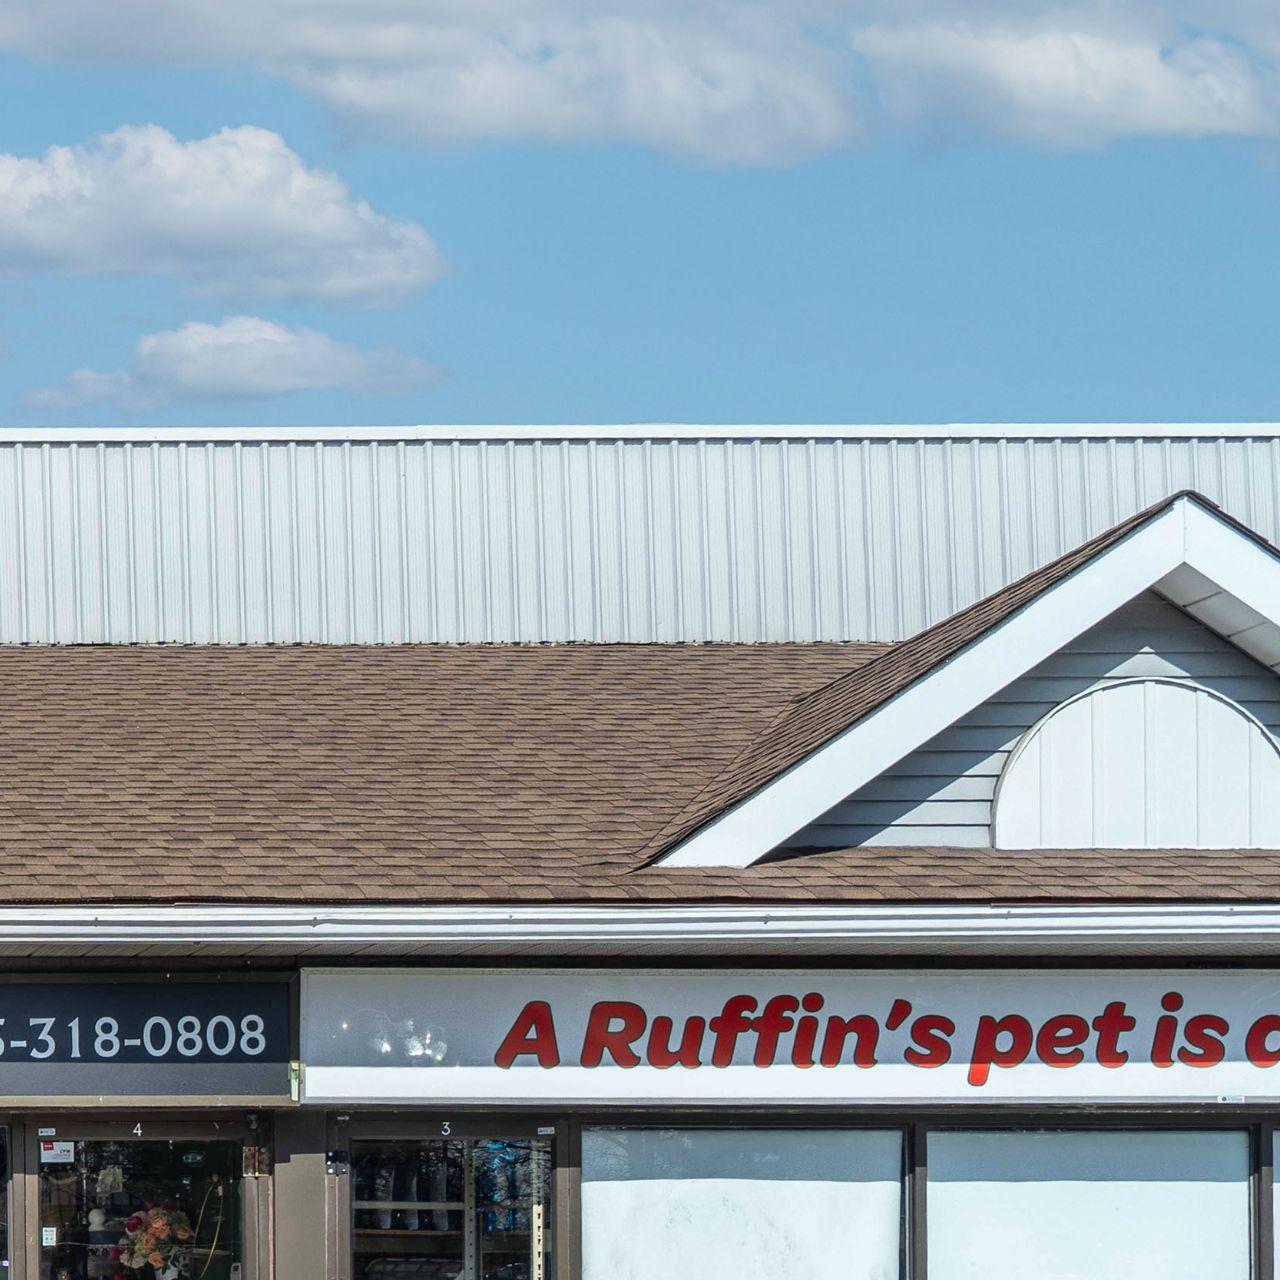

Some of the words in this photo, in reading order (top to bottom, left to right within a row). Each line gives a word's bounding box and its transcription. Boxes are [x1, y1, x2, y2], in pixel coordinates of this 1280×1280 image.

[494, 1000, 560, 1069] A
[580, 992, 953, 1069] Ruffin's
[967, 1001, 1137, 1086] pet
[1150, 992, 1230, 1068] is
[132, 1122, 143, 1137] 4
[441, 1121, 451, 1136] 3
